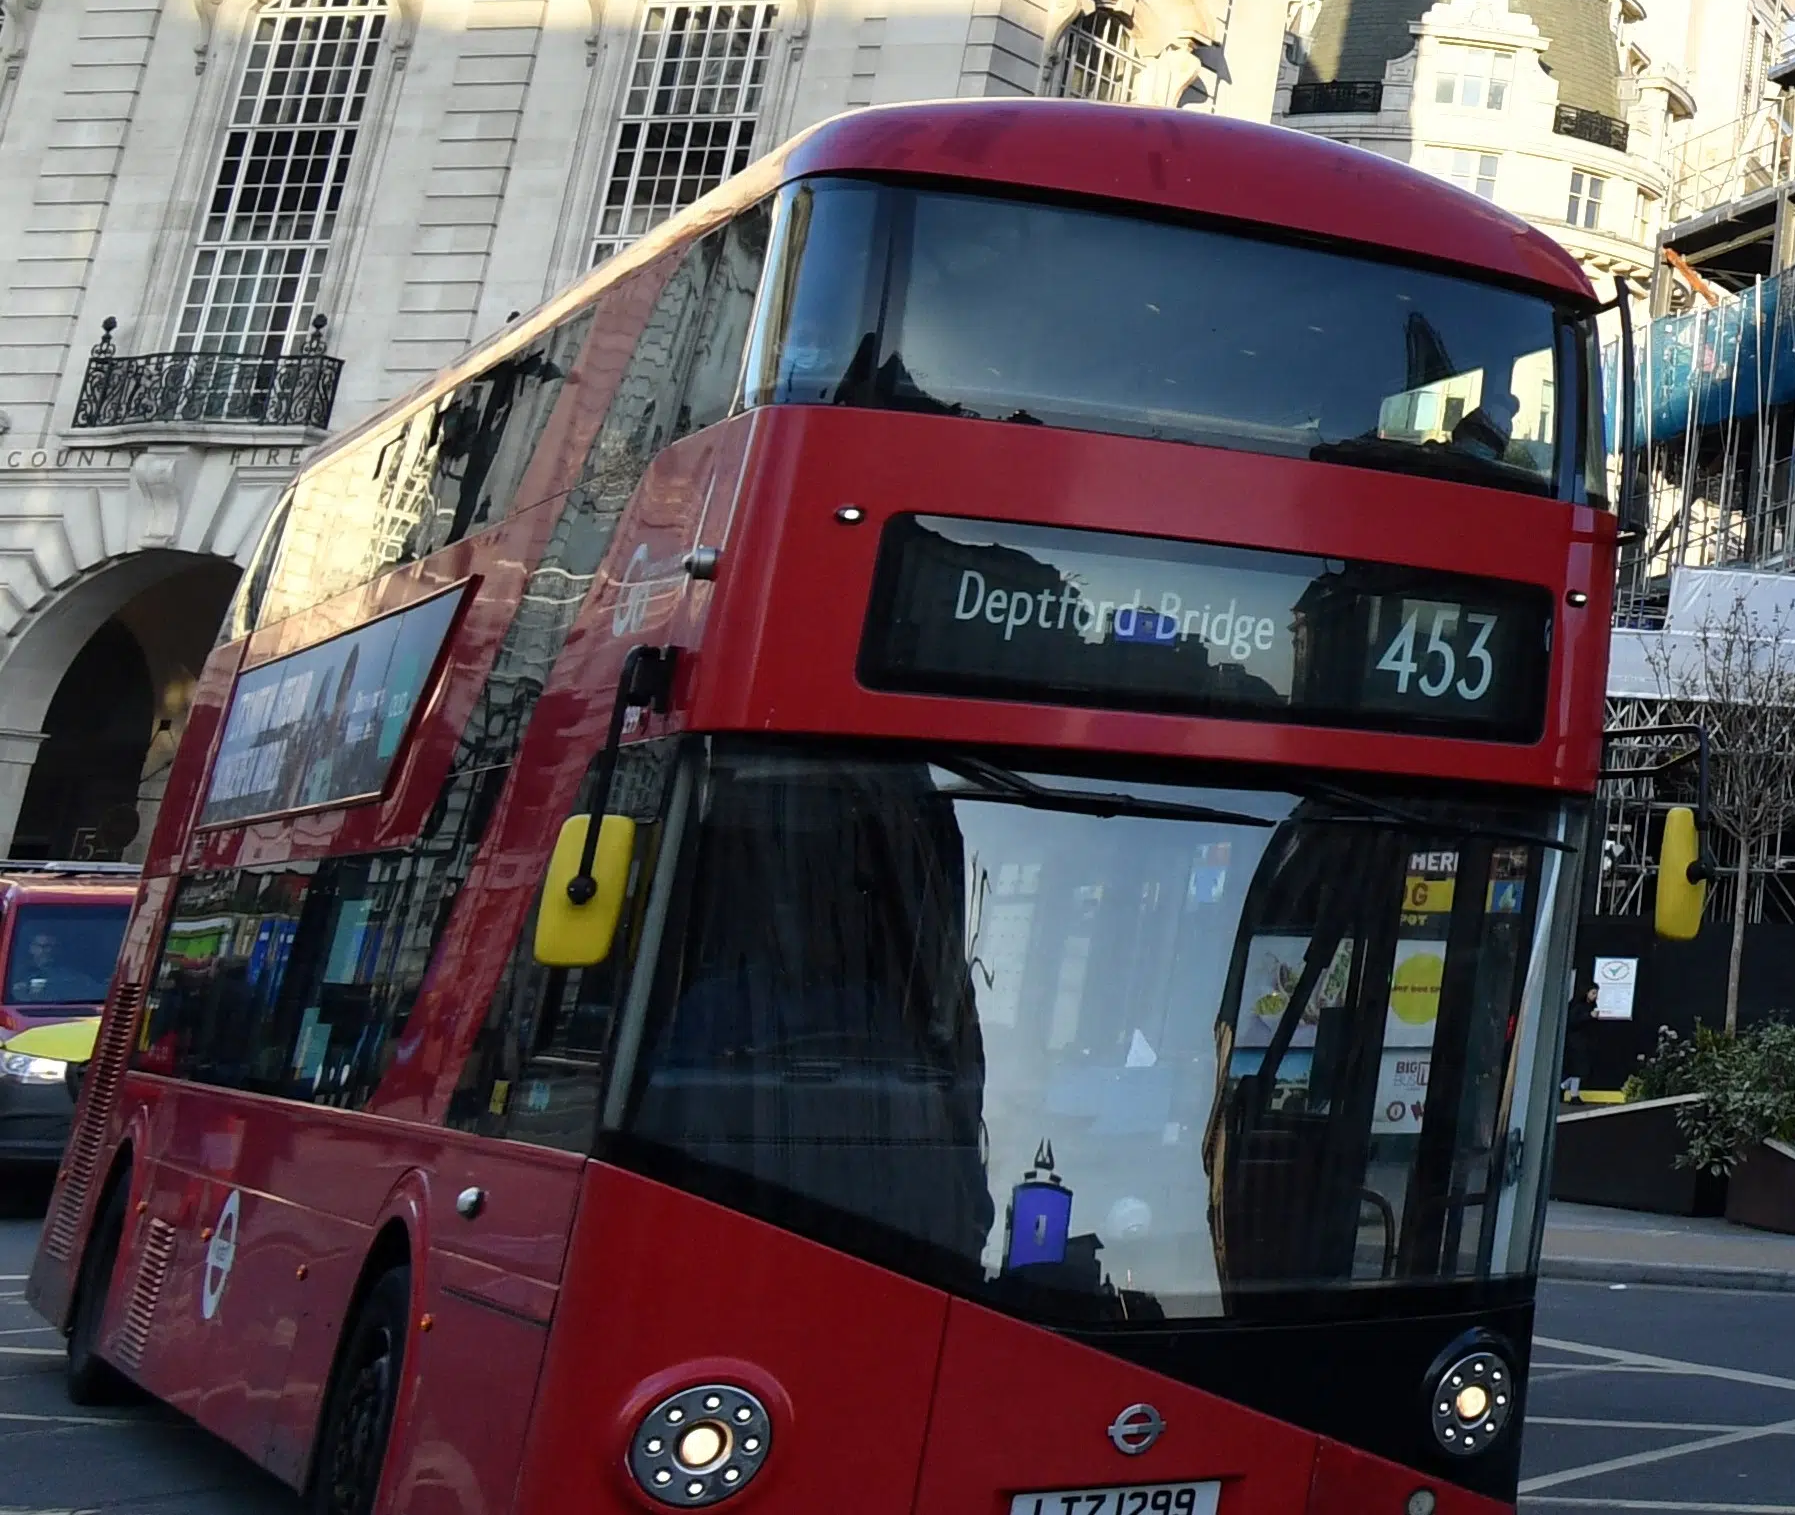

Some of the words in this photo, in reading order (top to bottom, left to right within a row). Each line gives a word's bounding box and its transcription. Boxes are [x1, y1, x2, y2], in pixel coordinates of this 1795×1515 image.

[7, 449, 142, 468] COUNTY
[229, 446, 302, 466] FIRE
[954, 569, 1143, 641] Deptford
[1155, 590, 1275, 659] Bridge
[1374, 600, 1498, 701] 453
[1396, 1061, 1418, 1074] BIG
[1115, 1488, 1196, 1515] 1299
